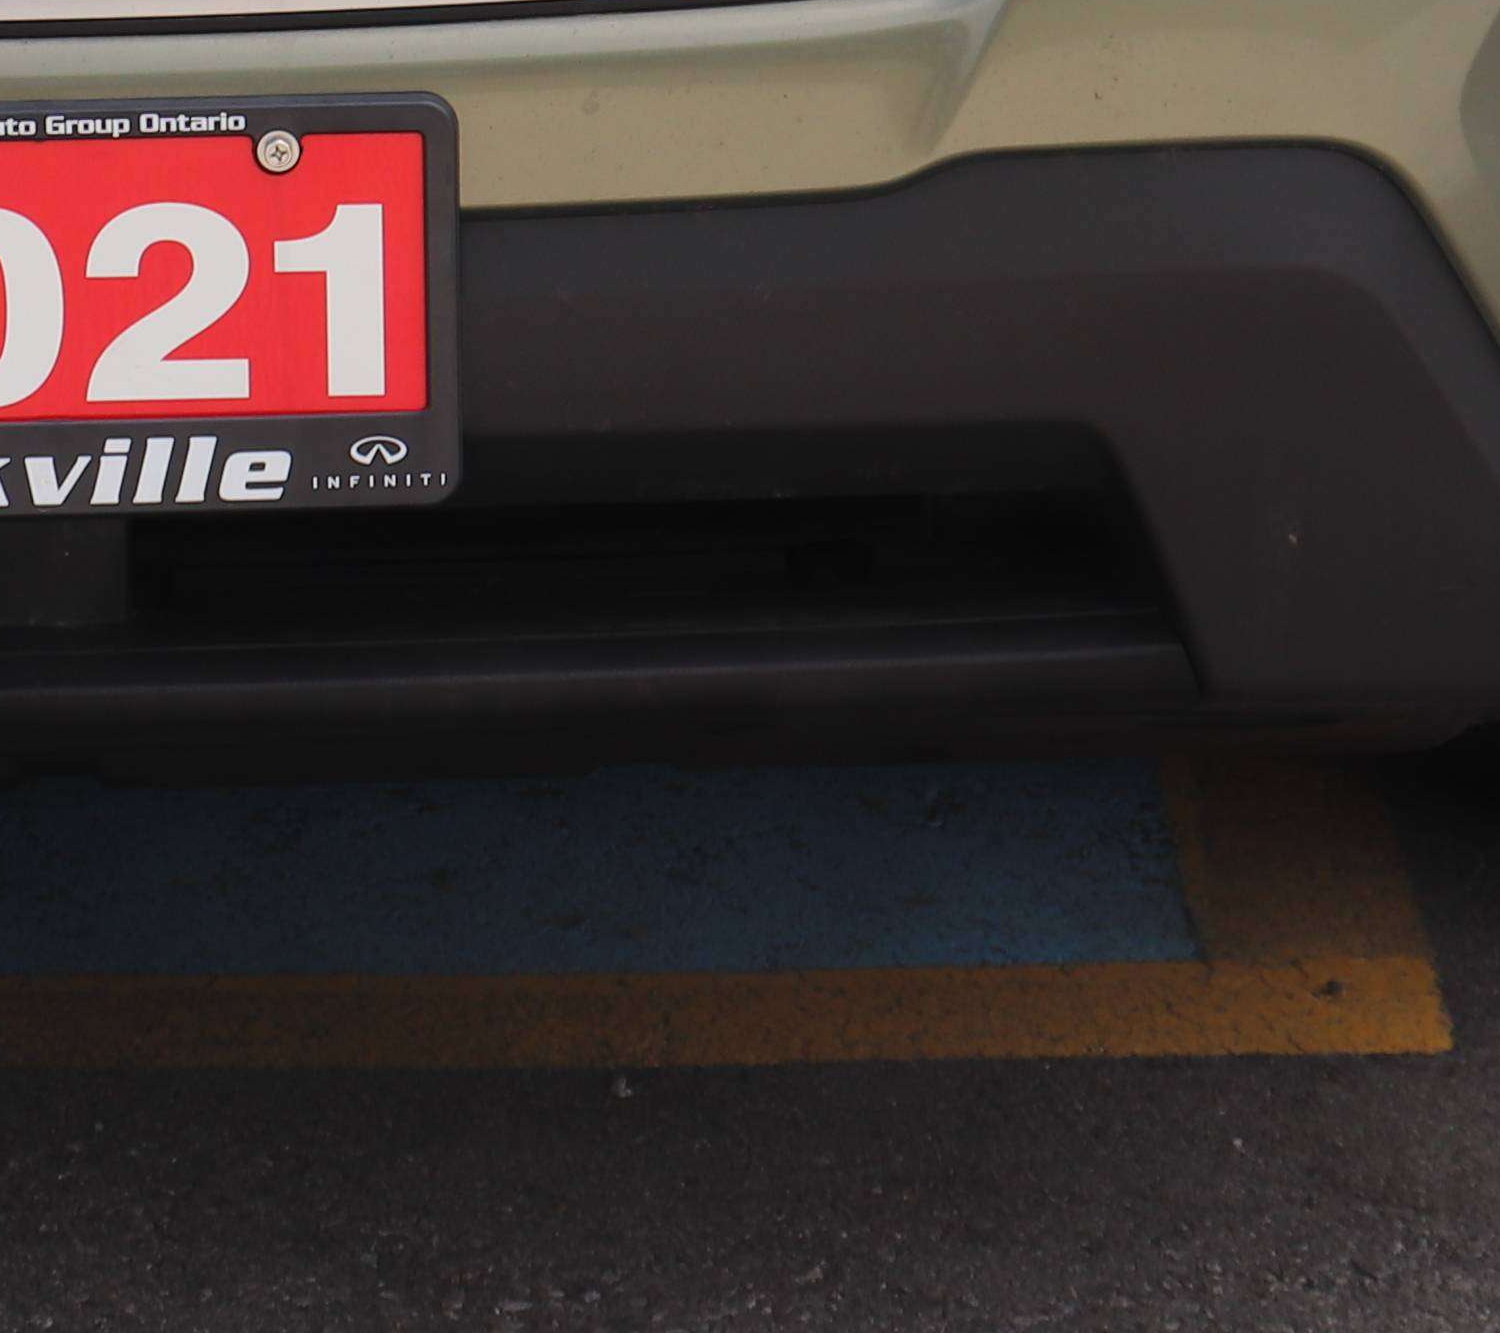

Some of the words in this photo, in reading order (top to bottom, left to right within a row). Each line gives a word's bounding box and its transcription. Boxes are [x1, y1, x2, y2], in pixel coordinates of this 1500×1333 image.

[45, 115, 130, 139] Group
[139, 112, 246, 134] Ontario
[312, 473, 446, 490] INFINITI
